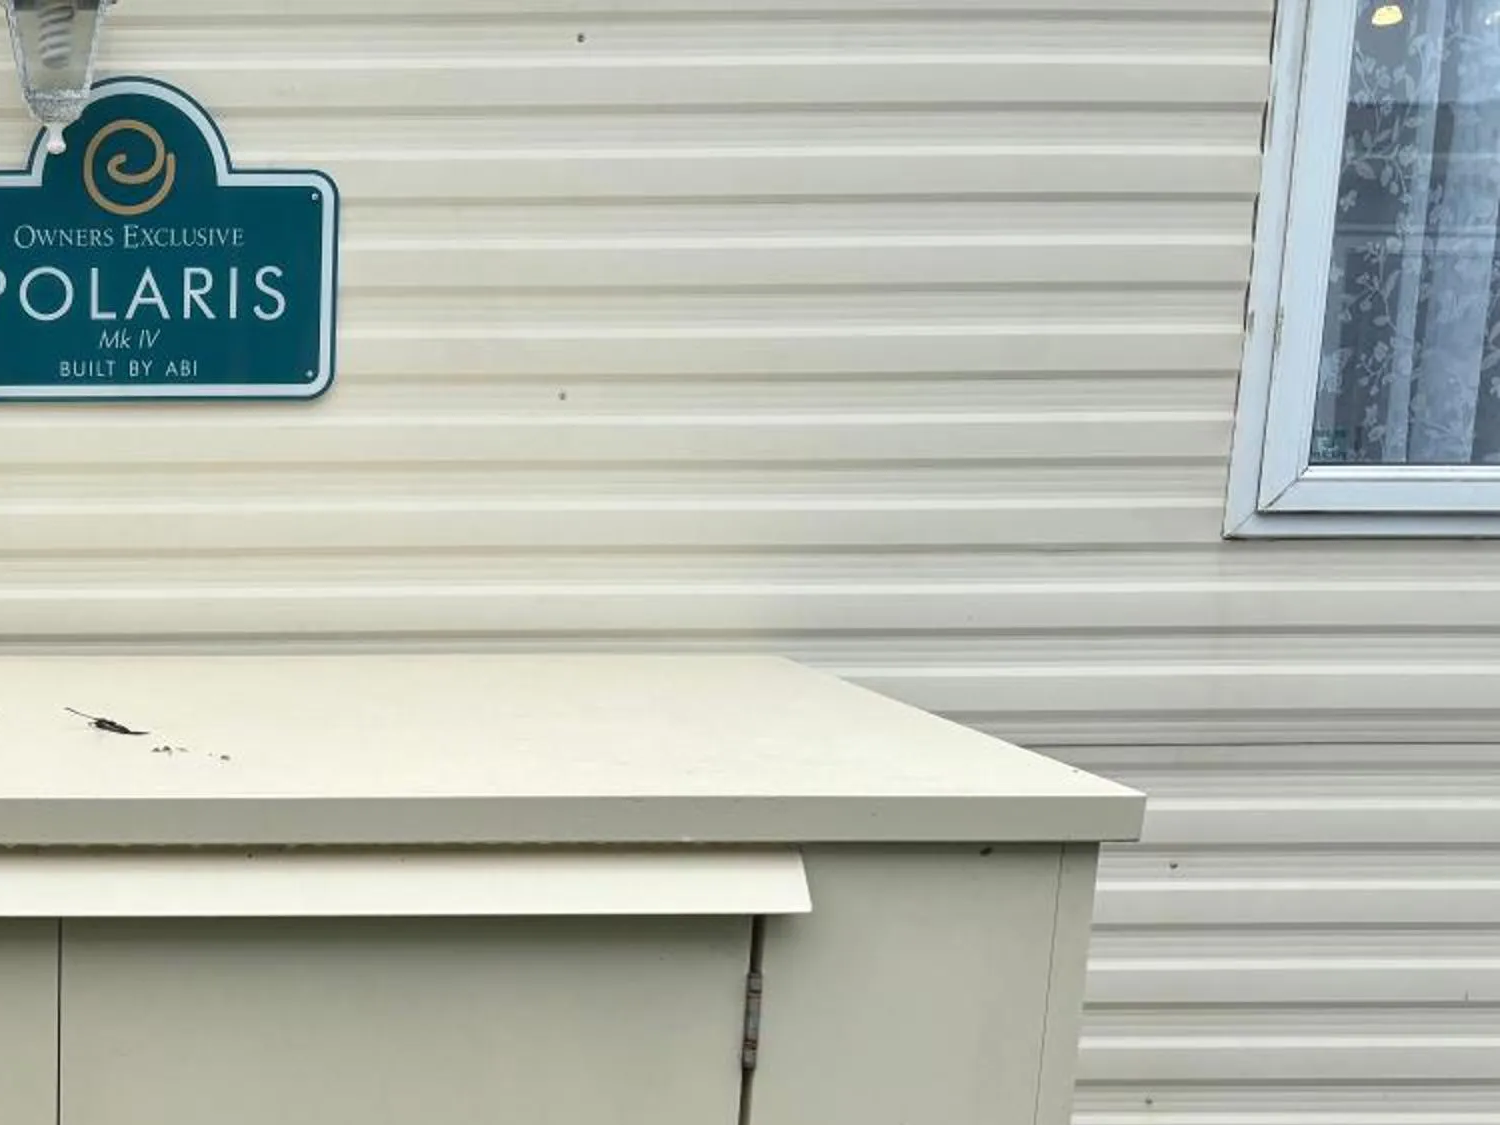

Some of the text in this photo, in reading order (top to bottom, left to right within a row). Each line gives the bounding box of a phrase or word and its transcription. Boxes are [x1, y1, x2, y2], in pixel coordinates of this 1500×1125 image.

[99, 329, 161, 349] Mk IV
[60, 360, 198, 378] BUILT BY ABI
